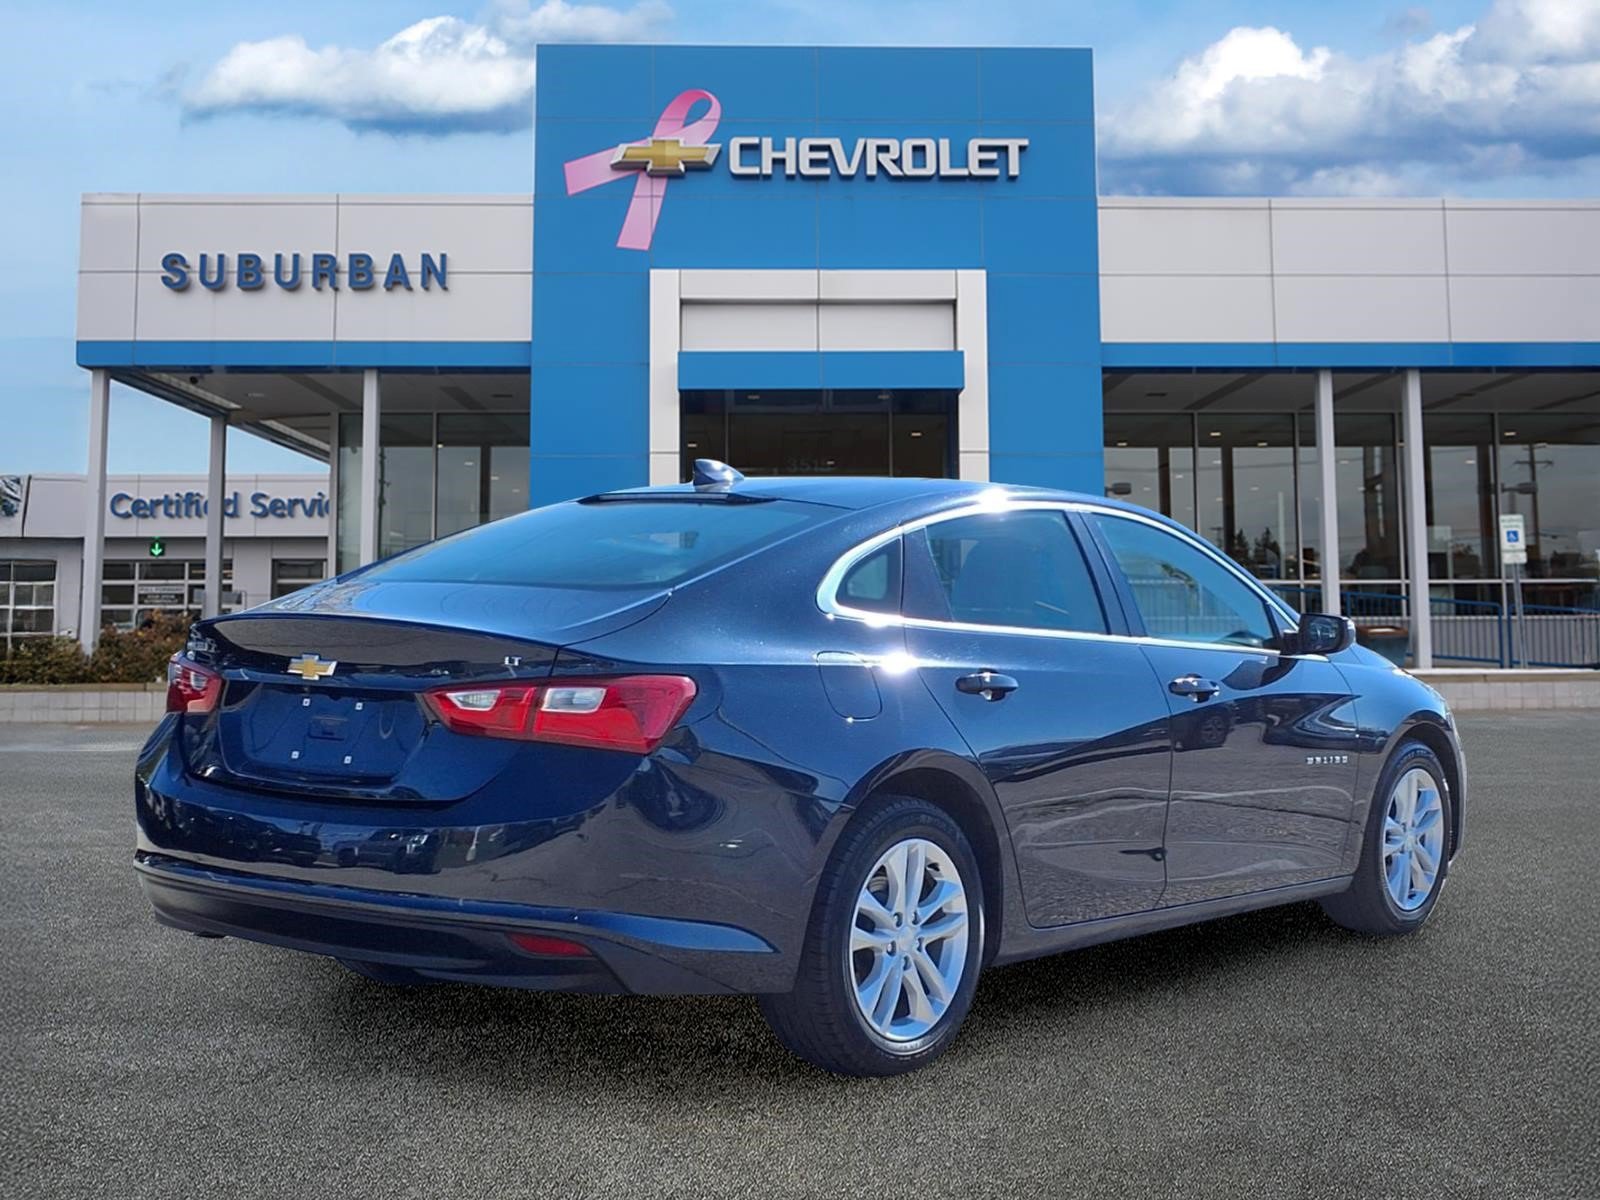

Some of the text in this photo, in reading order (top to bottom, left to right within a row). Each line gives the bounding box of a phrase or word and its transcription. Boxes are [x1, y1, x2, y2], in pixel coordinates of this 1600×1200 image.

[729, 137, 1029, 176] CHEVROLET
[161, 253, 448, 291] SUBURBAN
[110, 491, 330, 519] Certifid Servi
[504, 656, 522, 667] LT
